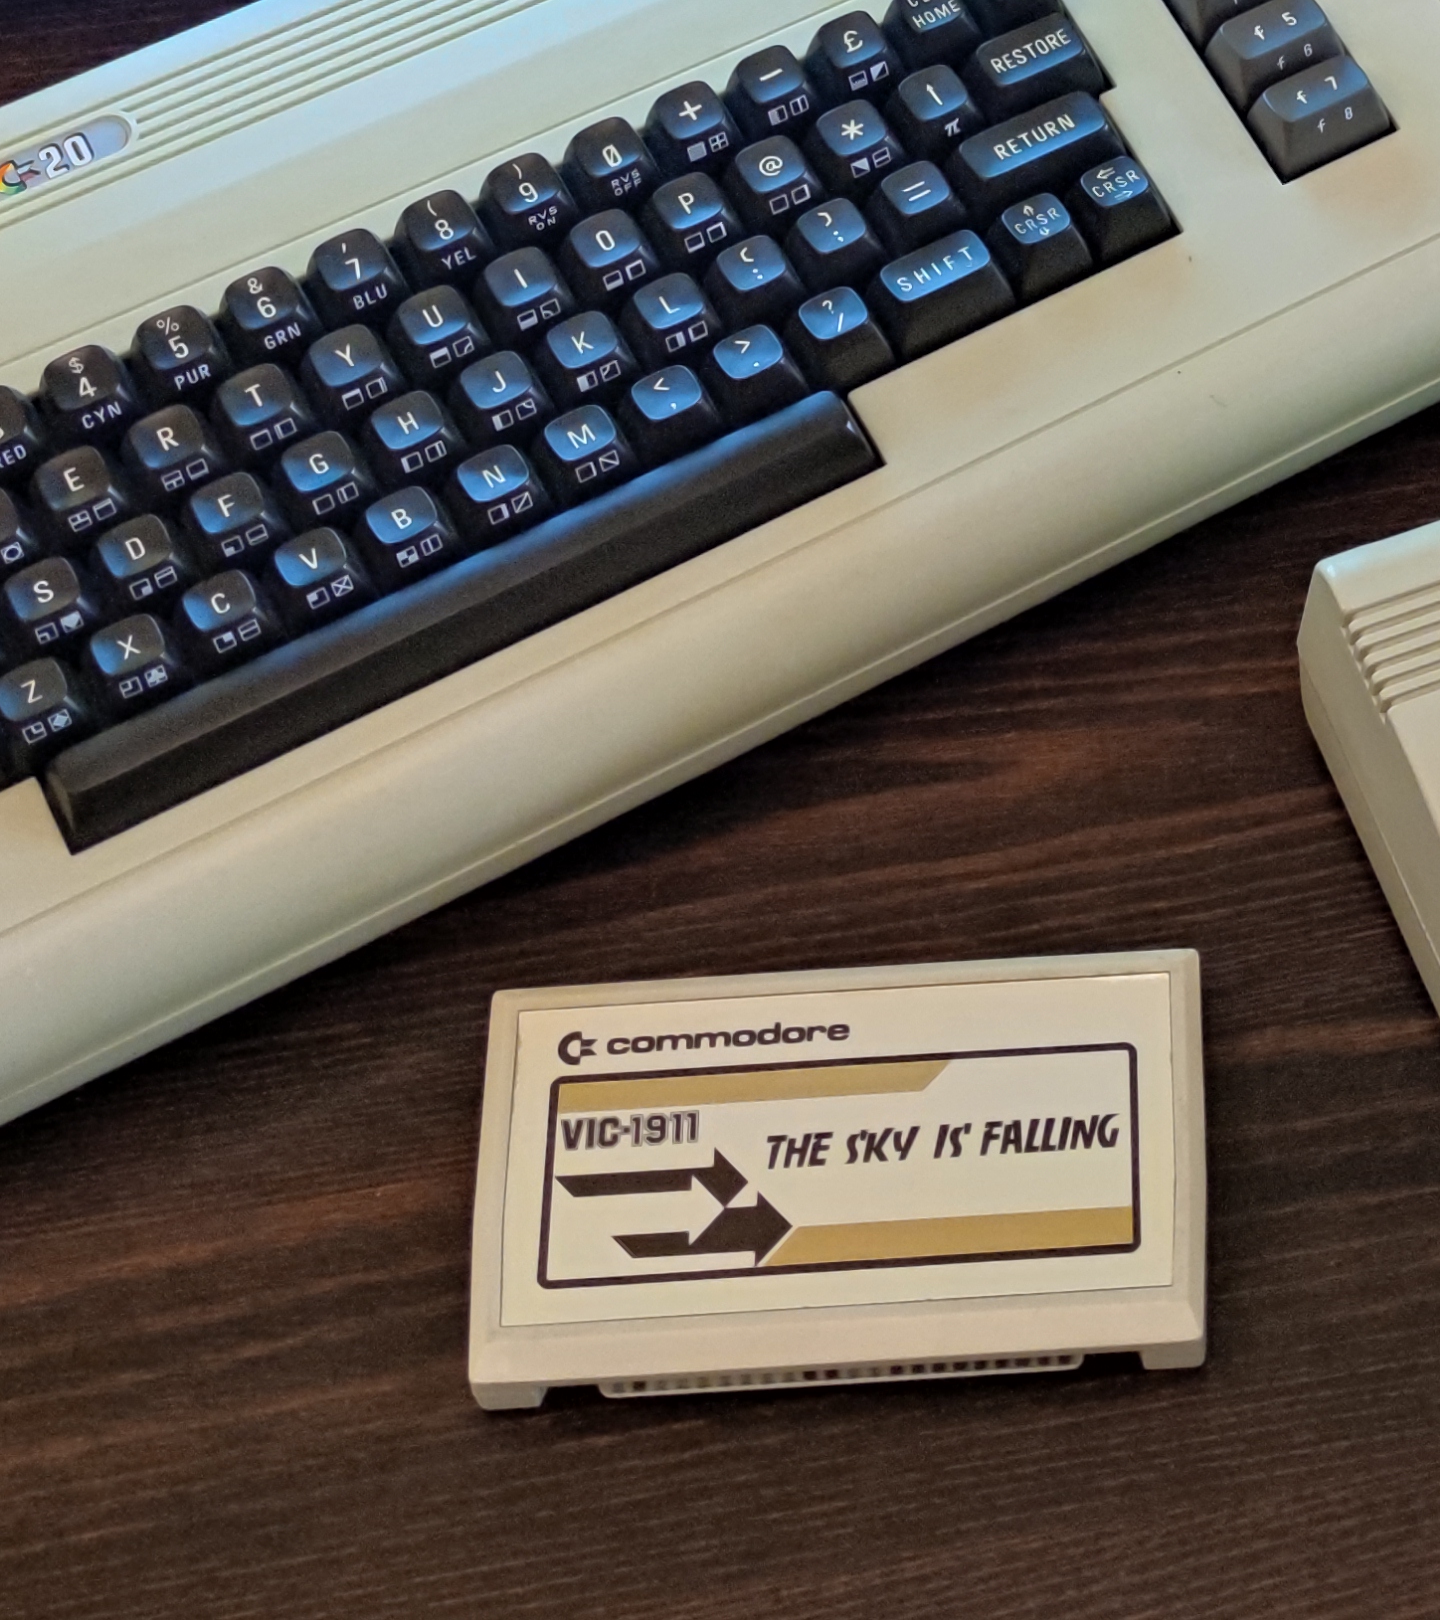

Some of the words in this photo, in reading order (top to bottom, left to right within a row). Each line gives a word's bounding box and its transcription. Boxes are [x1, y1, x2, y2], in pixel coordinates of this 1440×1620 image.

[989, 27, 1072, 74] RESTORE
[992, 114, 1076, 159] RETURN
[1088, 169, 1140, 200] CRSR
[1012, 208, 1063, 236] CRSR
[441, 247, 477, 269] YEL
[895, 245, 972, 294] SHIFT
[351, 284, 389, 310] BLU
[262, 322, 302, 351] GRN
[172, 363, 211, 390] PUR
[80, 402, 122, 430] CYN
[605, 1021, 852, 1057] commodore
[560, 1109, 700, 1151] VIC-1911
[765, 1130, 832, 1170] THE
[845, 1123, 920, 1165] SKY
[933, 1122, 973, 1160] IS
[978, 1112, 1120, 1156] FALLING
